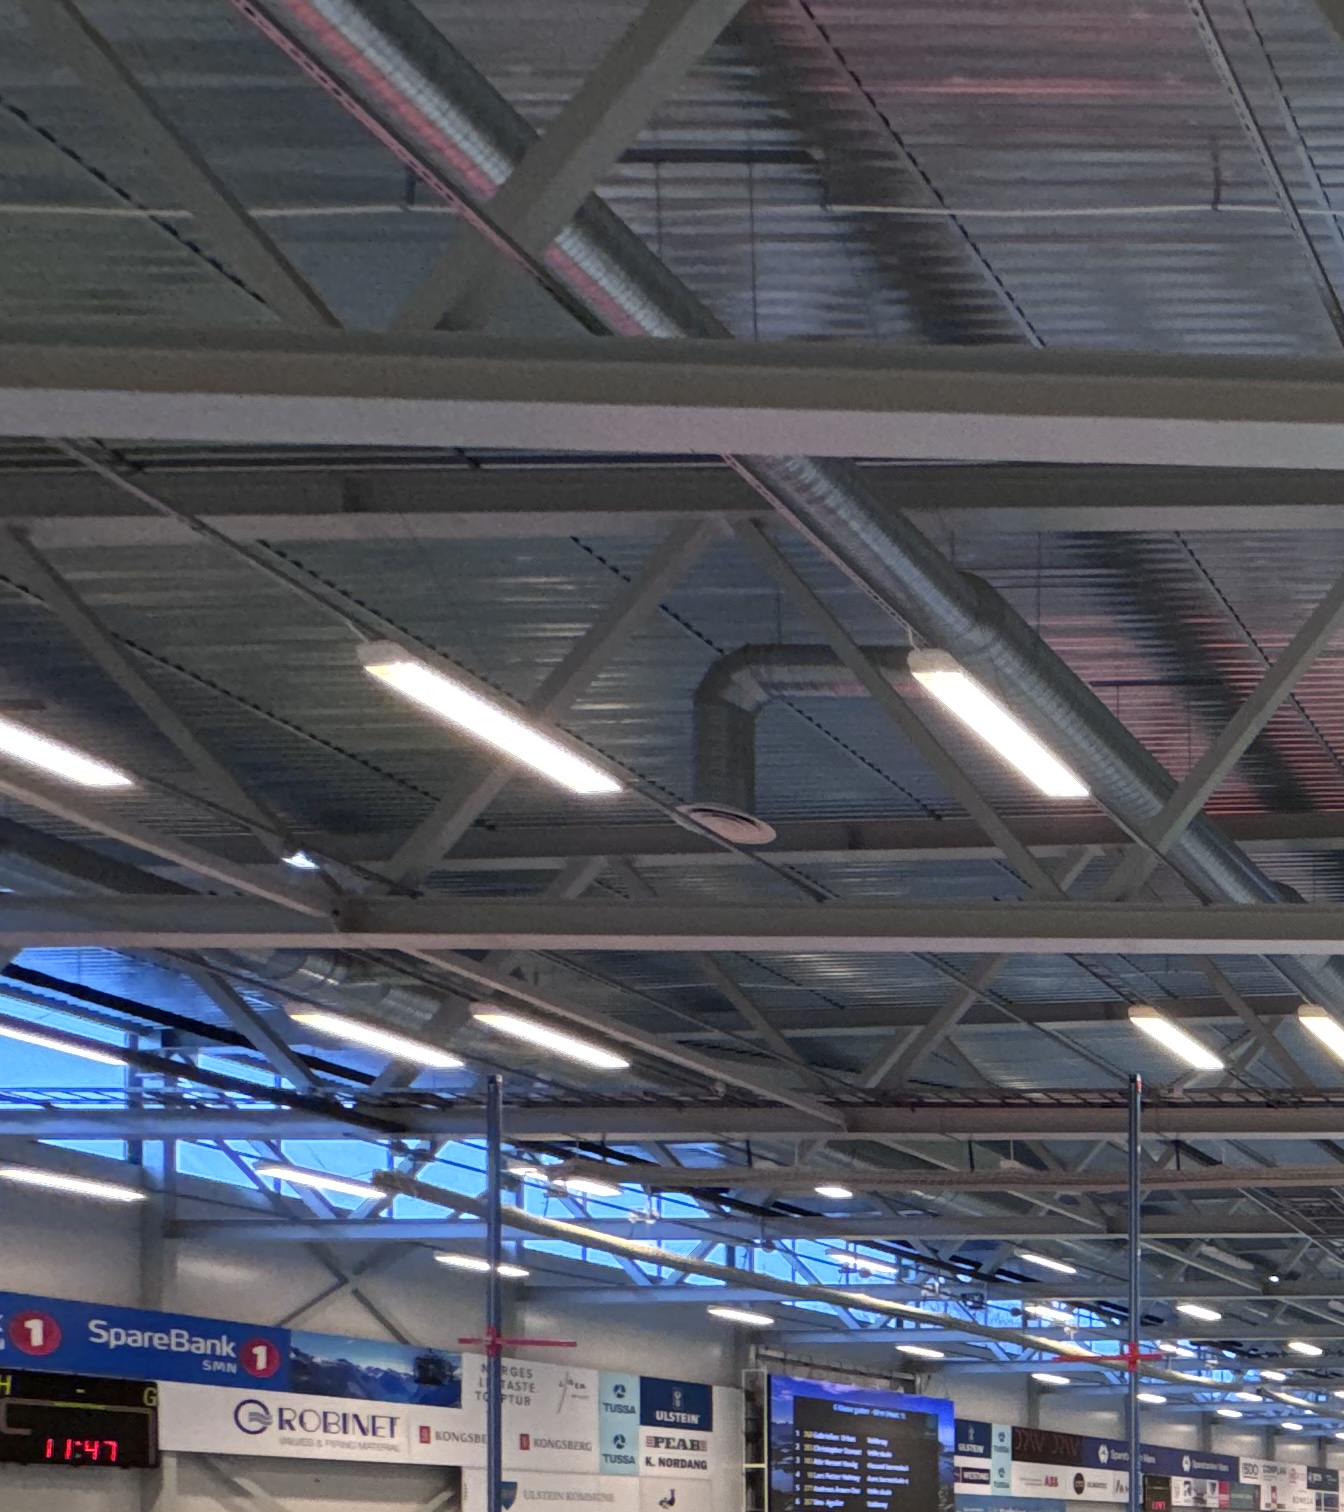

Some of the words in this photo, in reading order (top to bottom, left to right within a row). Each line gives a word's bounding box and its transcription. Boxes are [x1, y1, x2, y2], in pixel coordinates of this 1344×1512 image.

[88, 1318, 237, 1359] SpareBank
[251, 1344, 268, 1371] 1
[202, 1358, 238, 1374] SMN
[602, 1402, 636, 1414] TUSSA
[277, 1406, 400, 1439] ROBINET
[655, 1410, 699, 1424] ULSTEIN
[44, 1438, 119, 1462] 11:47
[533, 1438, 593, 1451] KONGSBERG
[602, 1453, 636, 1465] TUSSA
[658, 1457, 708, 1470] NORDANG
